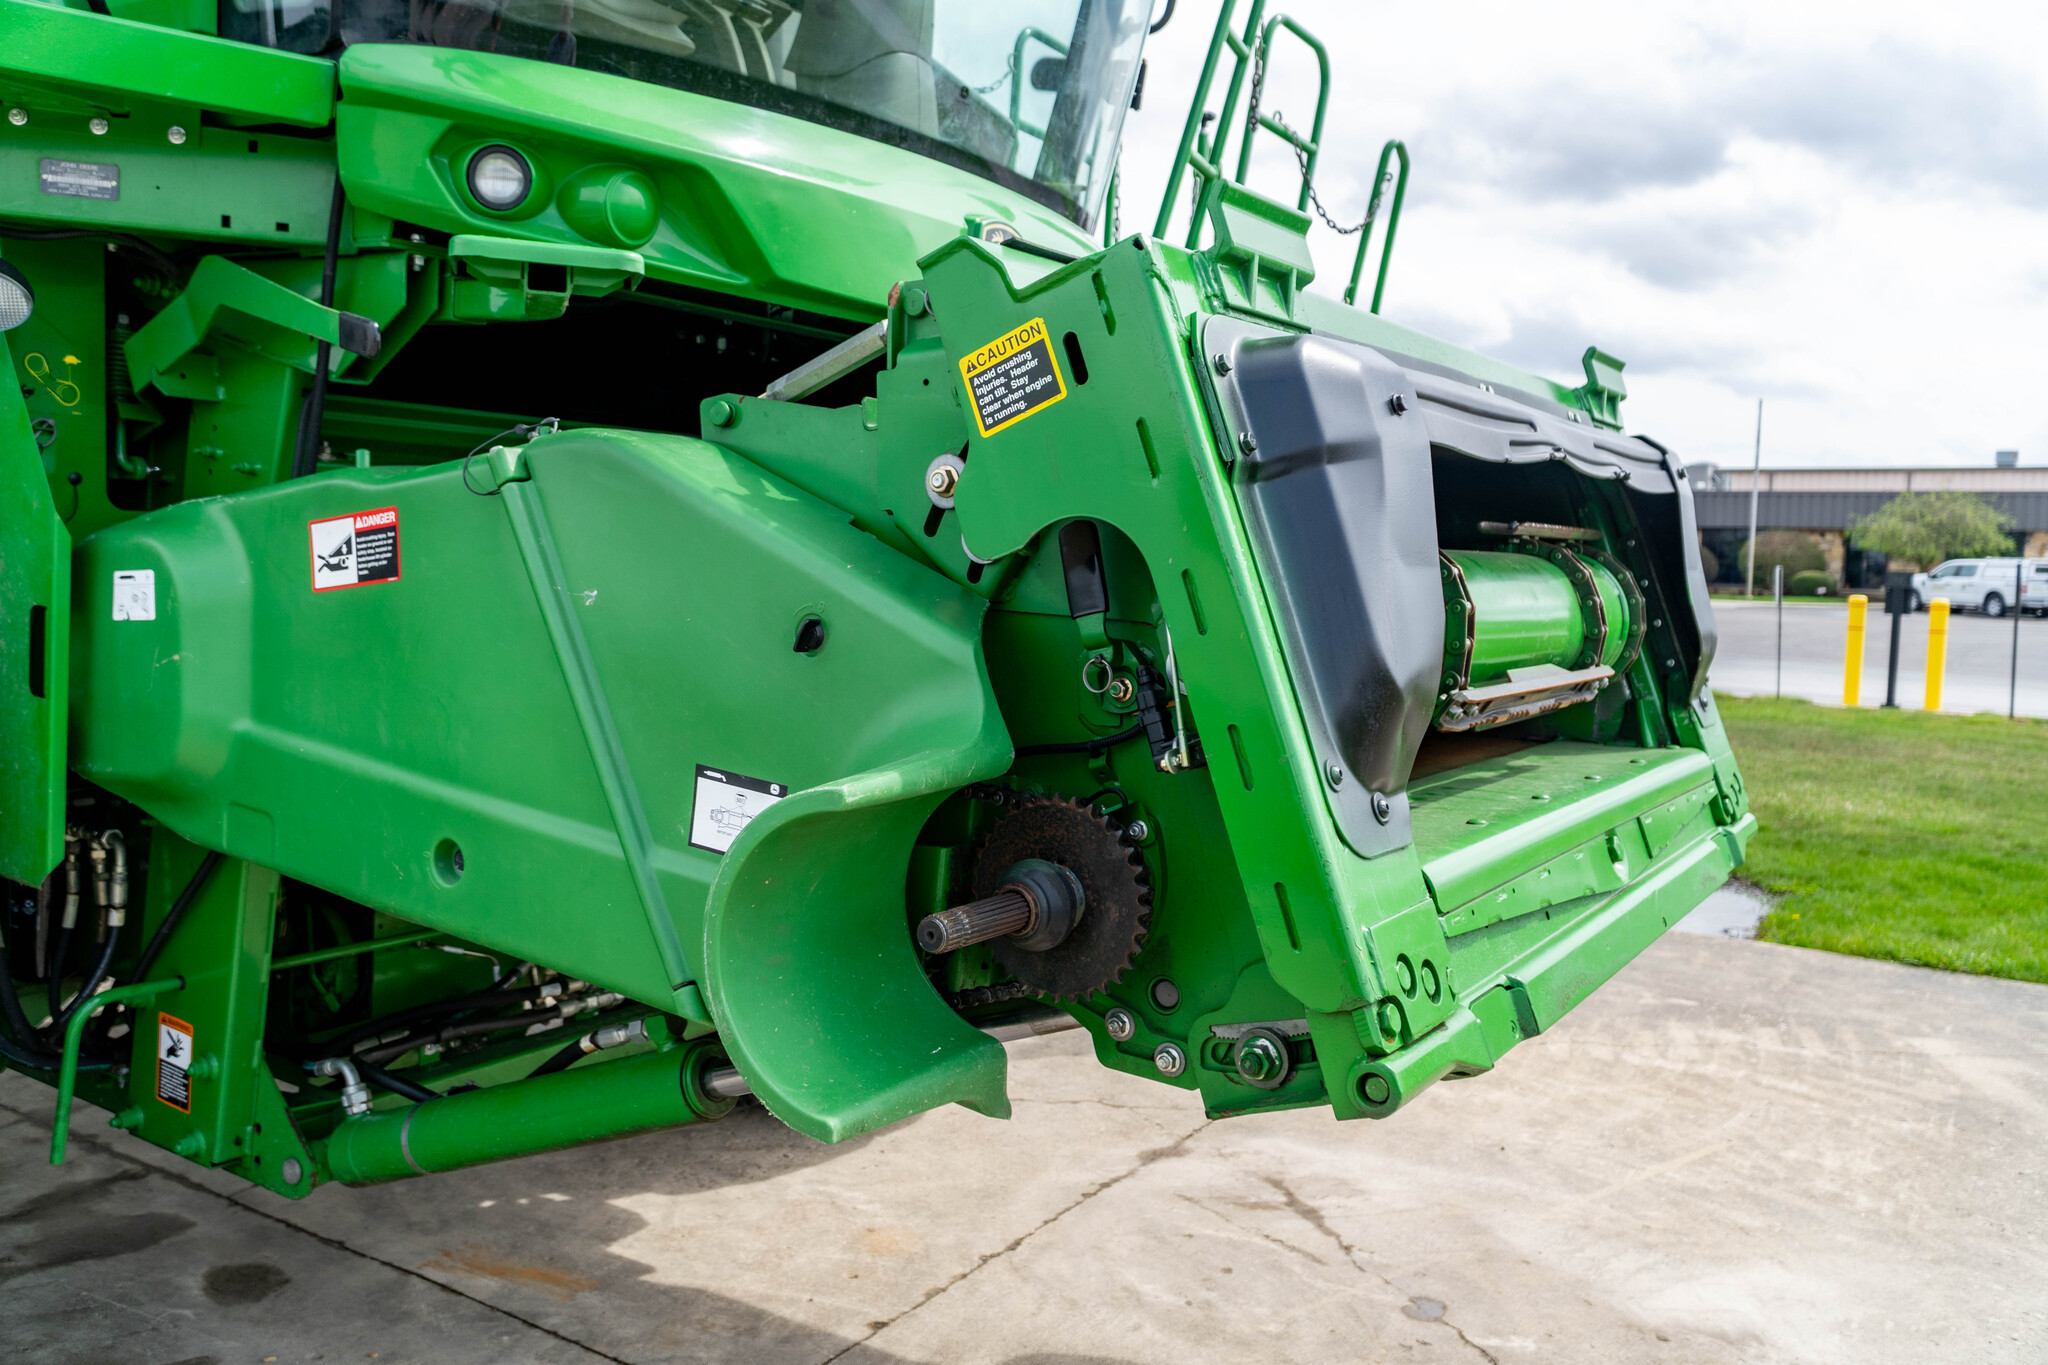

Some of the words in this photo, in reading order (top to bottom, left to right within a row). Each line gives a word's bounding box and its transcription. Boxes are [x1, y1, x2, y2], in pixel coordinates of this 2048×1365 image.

[976, 322, 1042, 367] CAUTION
[973, 368, 996, 387] Avoid
[997, 350, 1032, 374] crushing
[975, 377, 1008, 396] injuries.
[1010, 358, 1039, 379] Header
[979, 393, 994, 406] can
[995, 385, 1009, 400] tilt.
[1010, 374, 1030, 390] Stay
[982, 400, 1002, 416] clear
[1002, 389, 1025, 405] when
[1025, 374, 1053, 394] engine
[984, 415, 994, 426] is
[994, 400, 1028, 421] running.
[362, 511, 396, 526] DANGER
